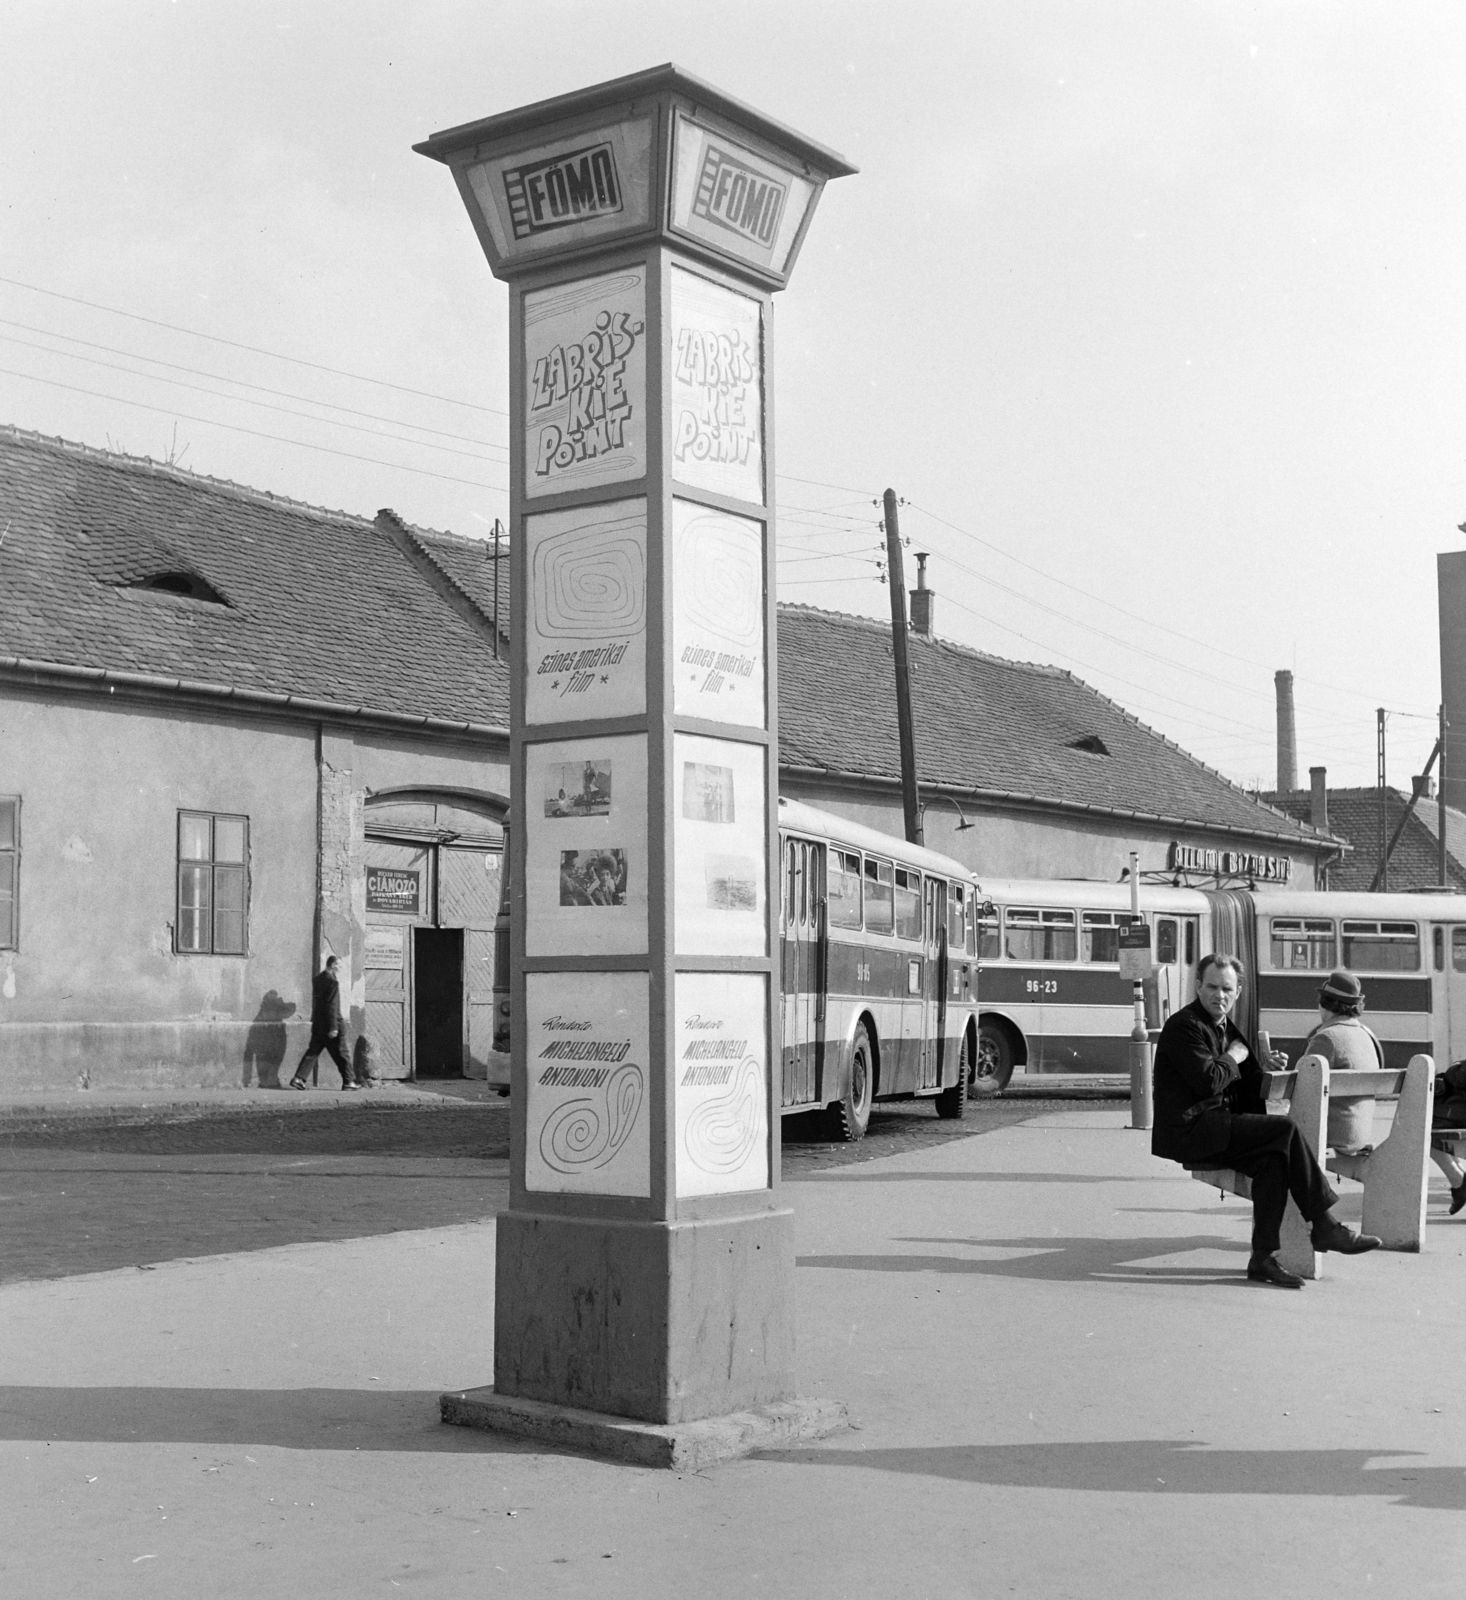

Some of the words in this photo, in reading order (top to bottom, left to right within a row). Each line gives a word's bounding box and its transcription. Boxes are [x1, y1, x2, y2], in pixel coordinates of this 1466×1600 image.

[573, 640, 630, 671] amerikai
[560, 671, 595, 697] film
[699, 669, 725, 693] film
[368, 874, 417, 894] CIÁNOZÓ
[1026, 980, 1057, 993] 96-23
[538, 1066, 610, 1088] ANTONIONI
[680, 1066, 733, 1086] ANTONIONI
